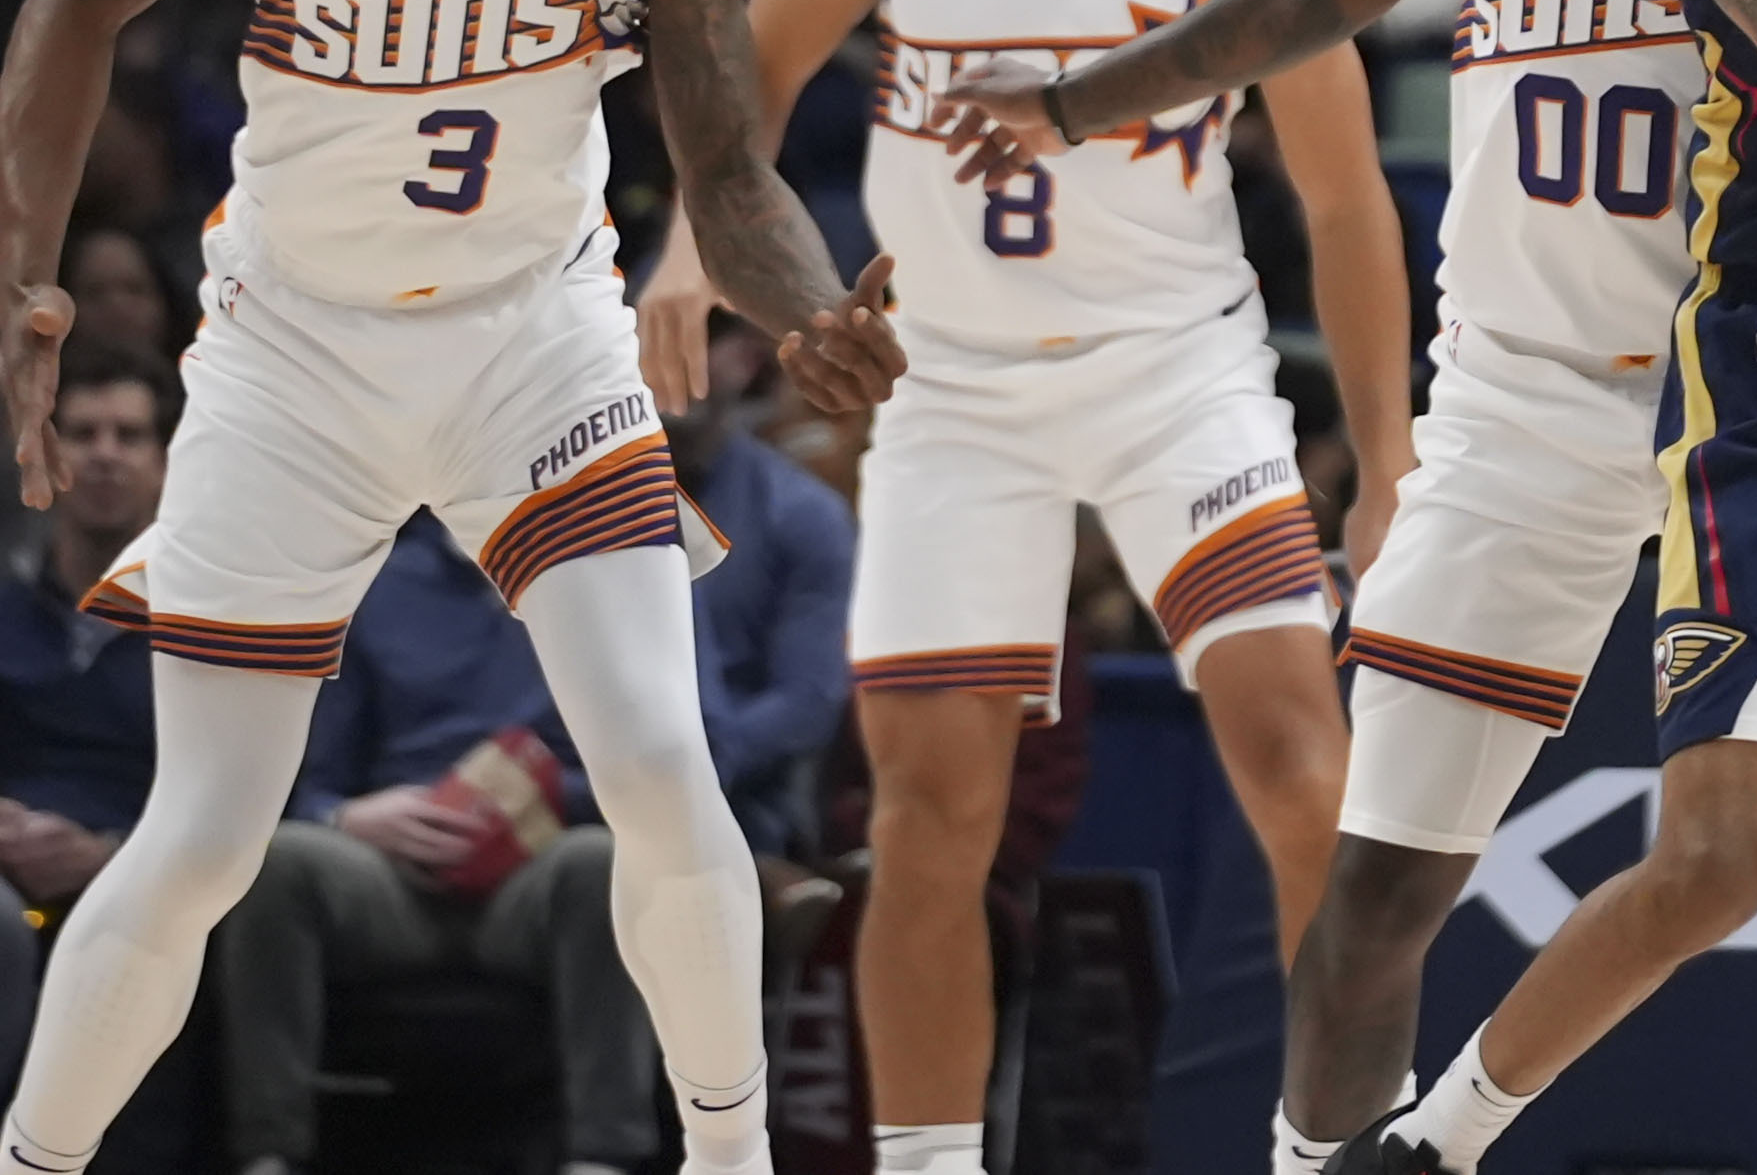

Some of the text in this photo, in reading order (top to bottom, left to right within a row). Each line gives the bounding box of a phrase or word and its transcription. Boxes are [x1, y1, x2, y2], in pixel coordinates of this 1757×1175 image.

[403, 109, 498, 215] 3
[1514, 72, 1678, 220] 00
[983, 160, 1056, 259] 8
[529, 391, 650, 492] PHOENIX
